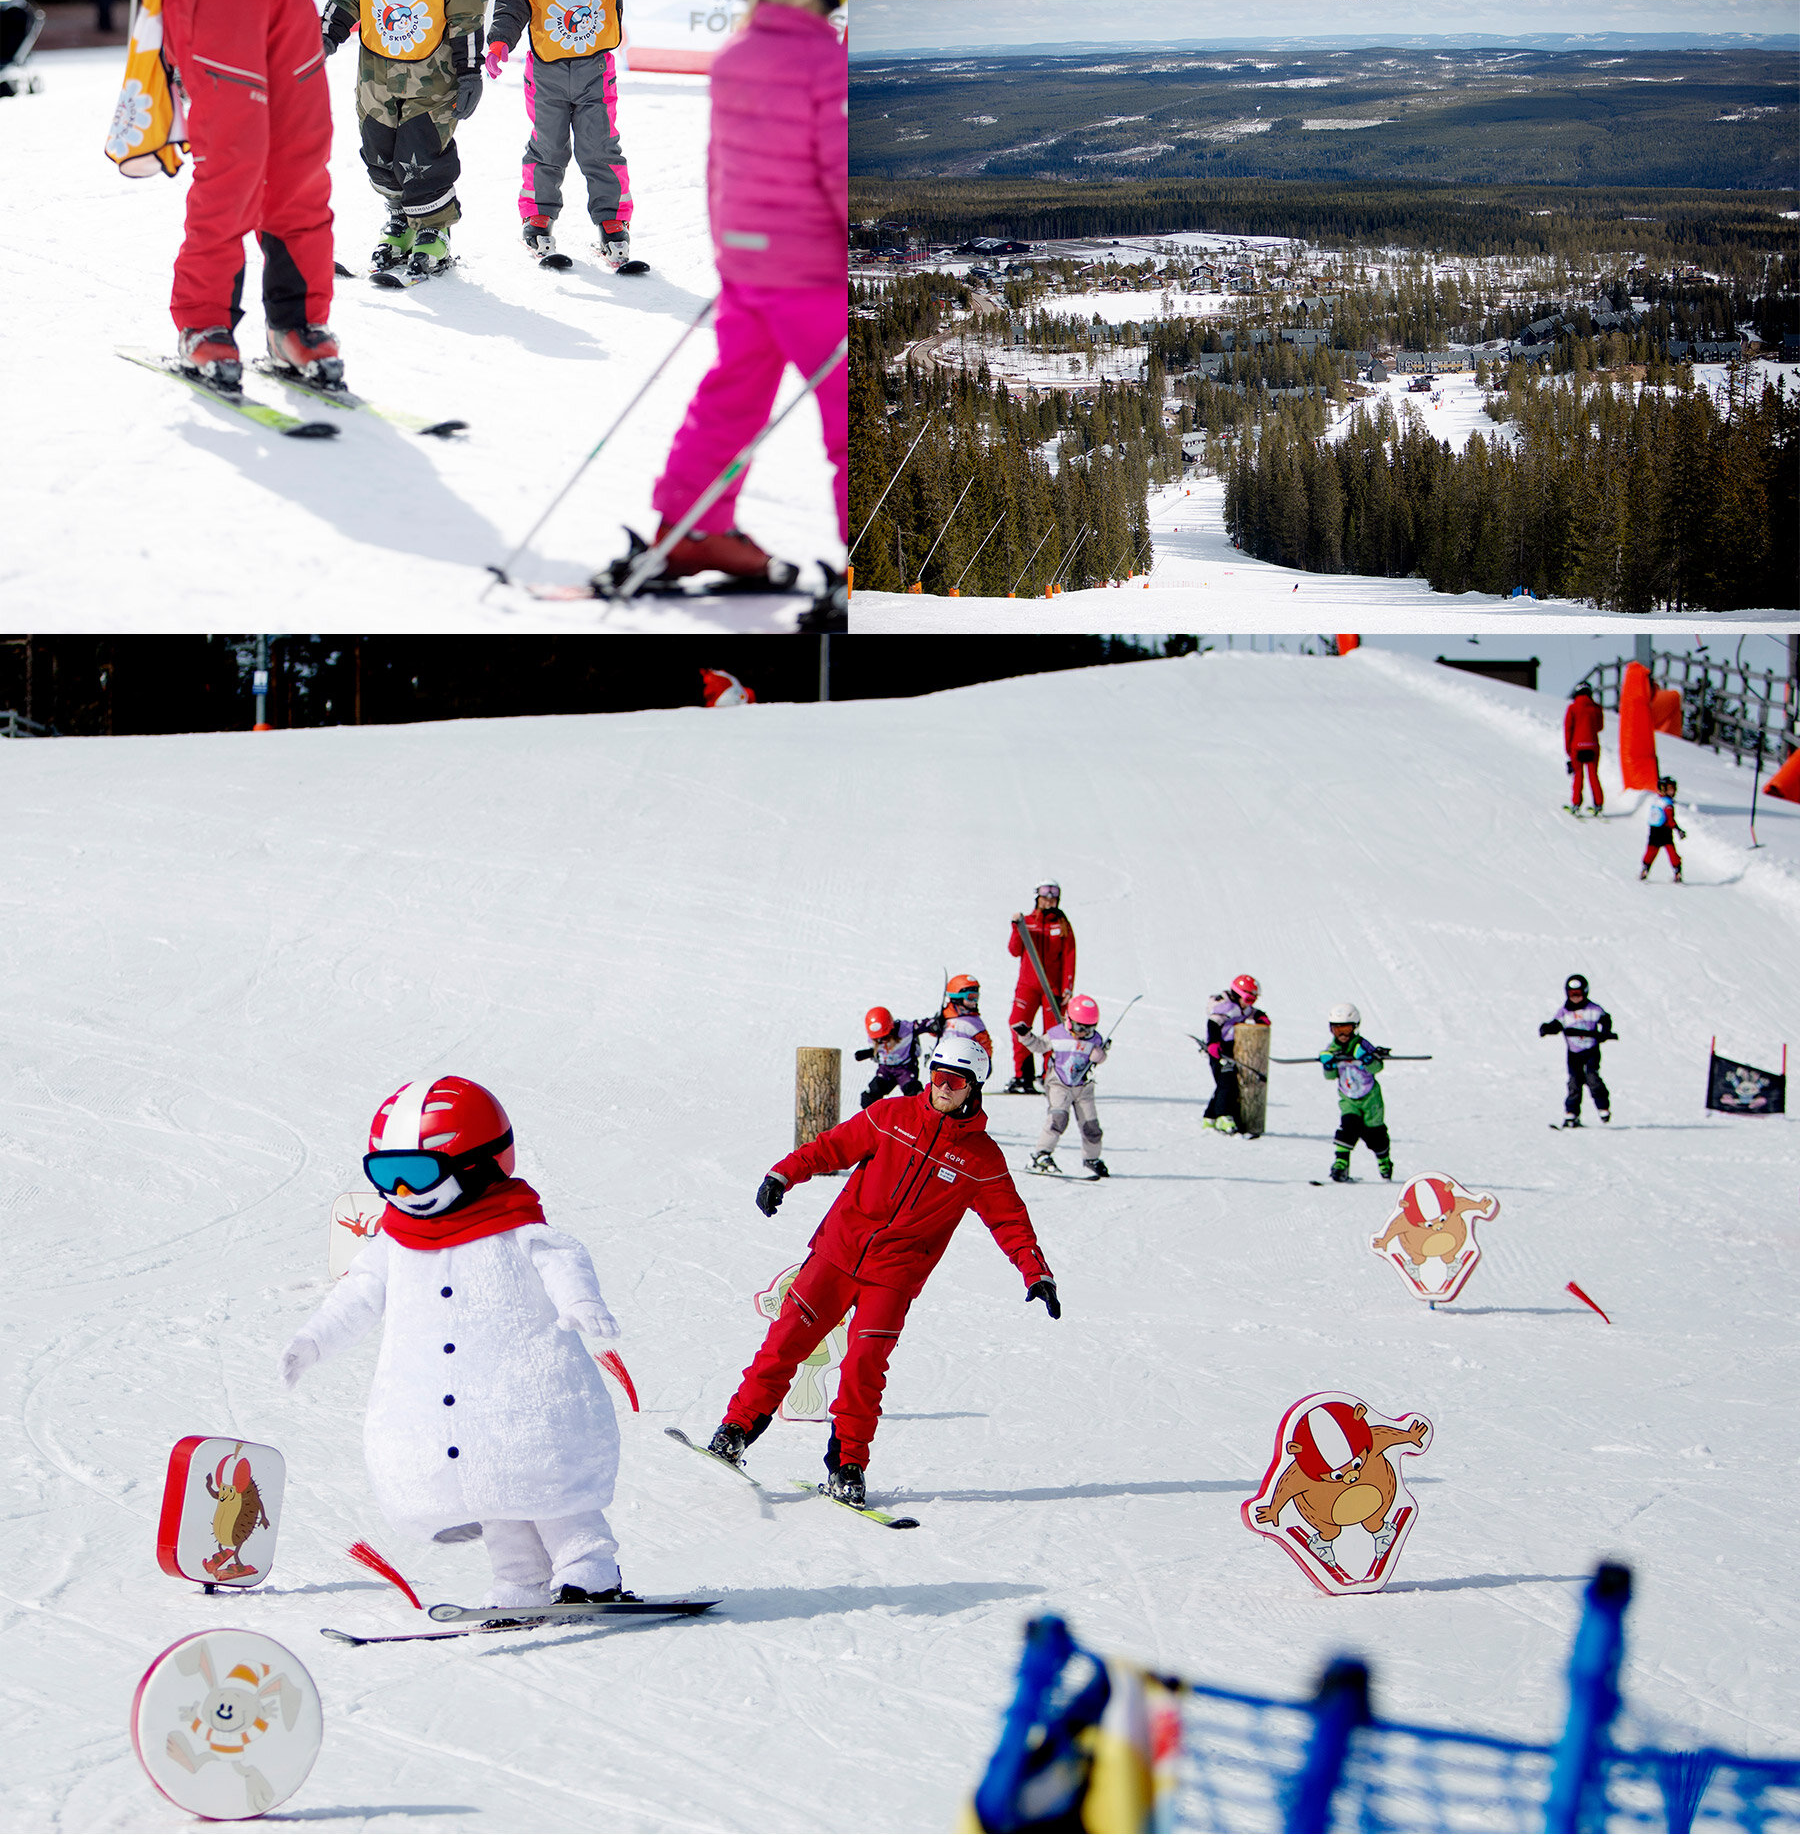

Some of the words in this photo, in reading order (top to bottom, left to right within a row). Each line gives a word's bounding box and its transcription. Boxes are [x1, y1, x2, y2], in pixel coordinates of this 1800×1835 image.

[388, 14, 419, 42] SKIDSKOLA
[556, 16, 572, 41] VALLES
[945, 1151, 965, 1166] EQPE
